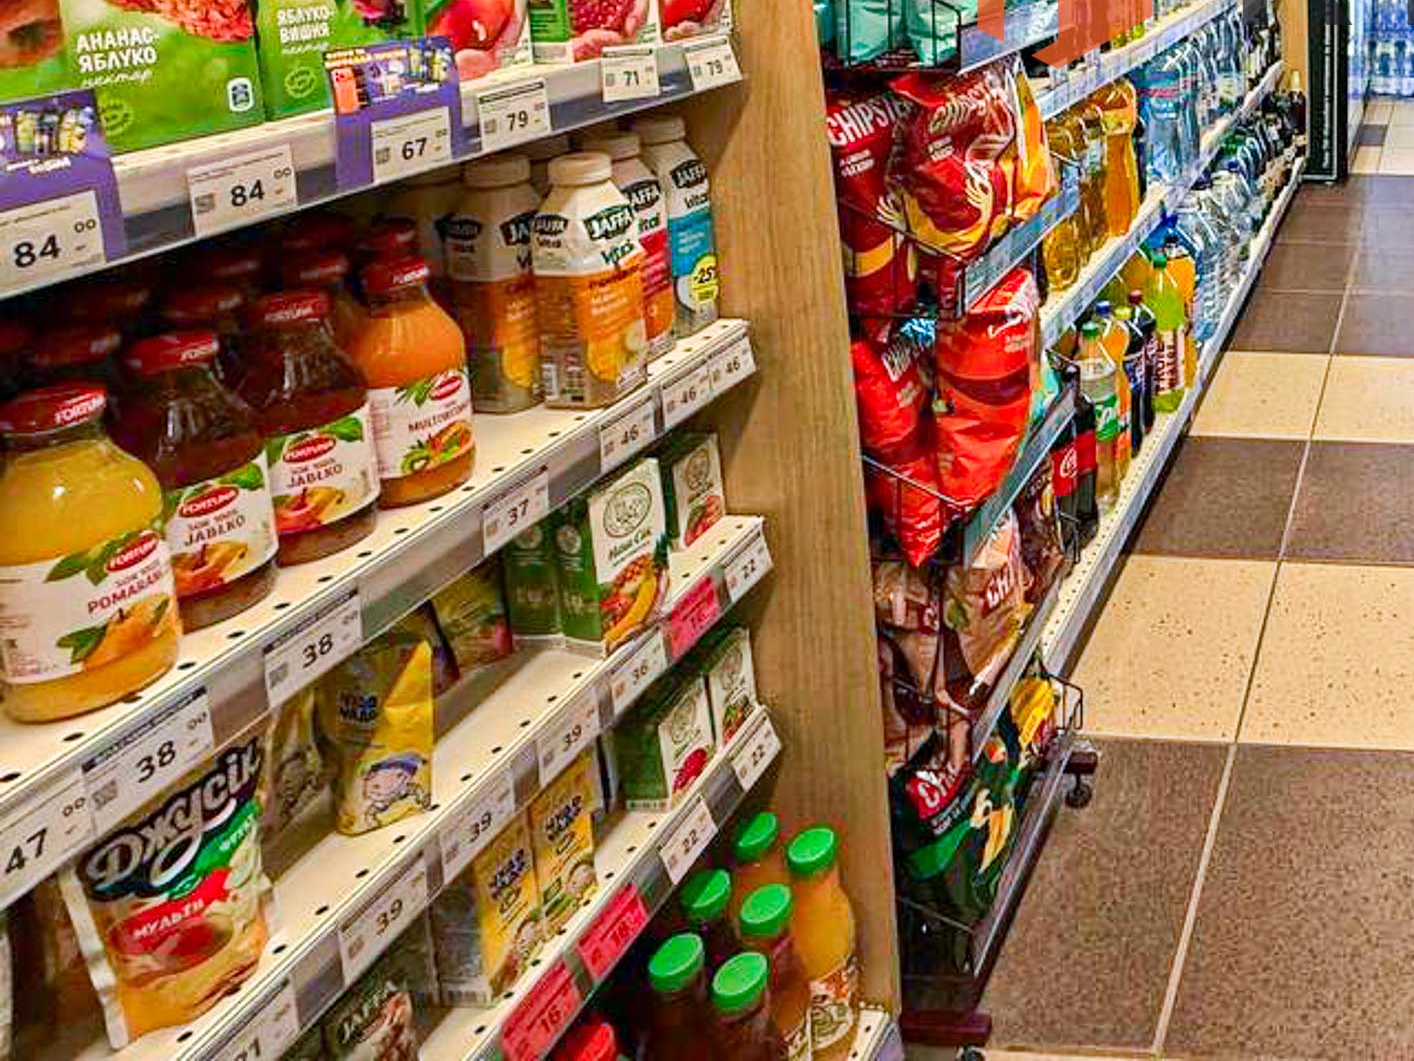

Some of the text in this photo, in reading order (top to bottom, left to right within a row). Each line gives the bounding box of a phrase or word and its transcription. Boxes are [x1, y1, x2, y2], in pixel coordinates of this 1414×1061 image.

[280, 22, 330, 44] ВИШНЯ
[79, 47, 158, 74] ЯБЛУКО
[706, 60, 724, 77] 79
[622, 69, 641, 87] 71
[506, 109, 529, 131] 79
[401, 137, 428, 161] 67
[230, 179, 265, 208] 84
[591, 206, 633, 240] JAFFA
[13, 234, 61, 269] 84
[507, 497, 529, 527] 37
[301, 634, 333, 669] 38
[136, 740, 177, 784] 38
[5, 827, 48, 875] 47
[375, 900, 404, 937] 39
